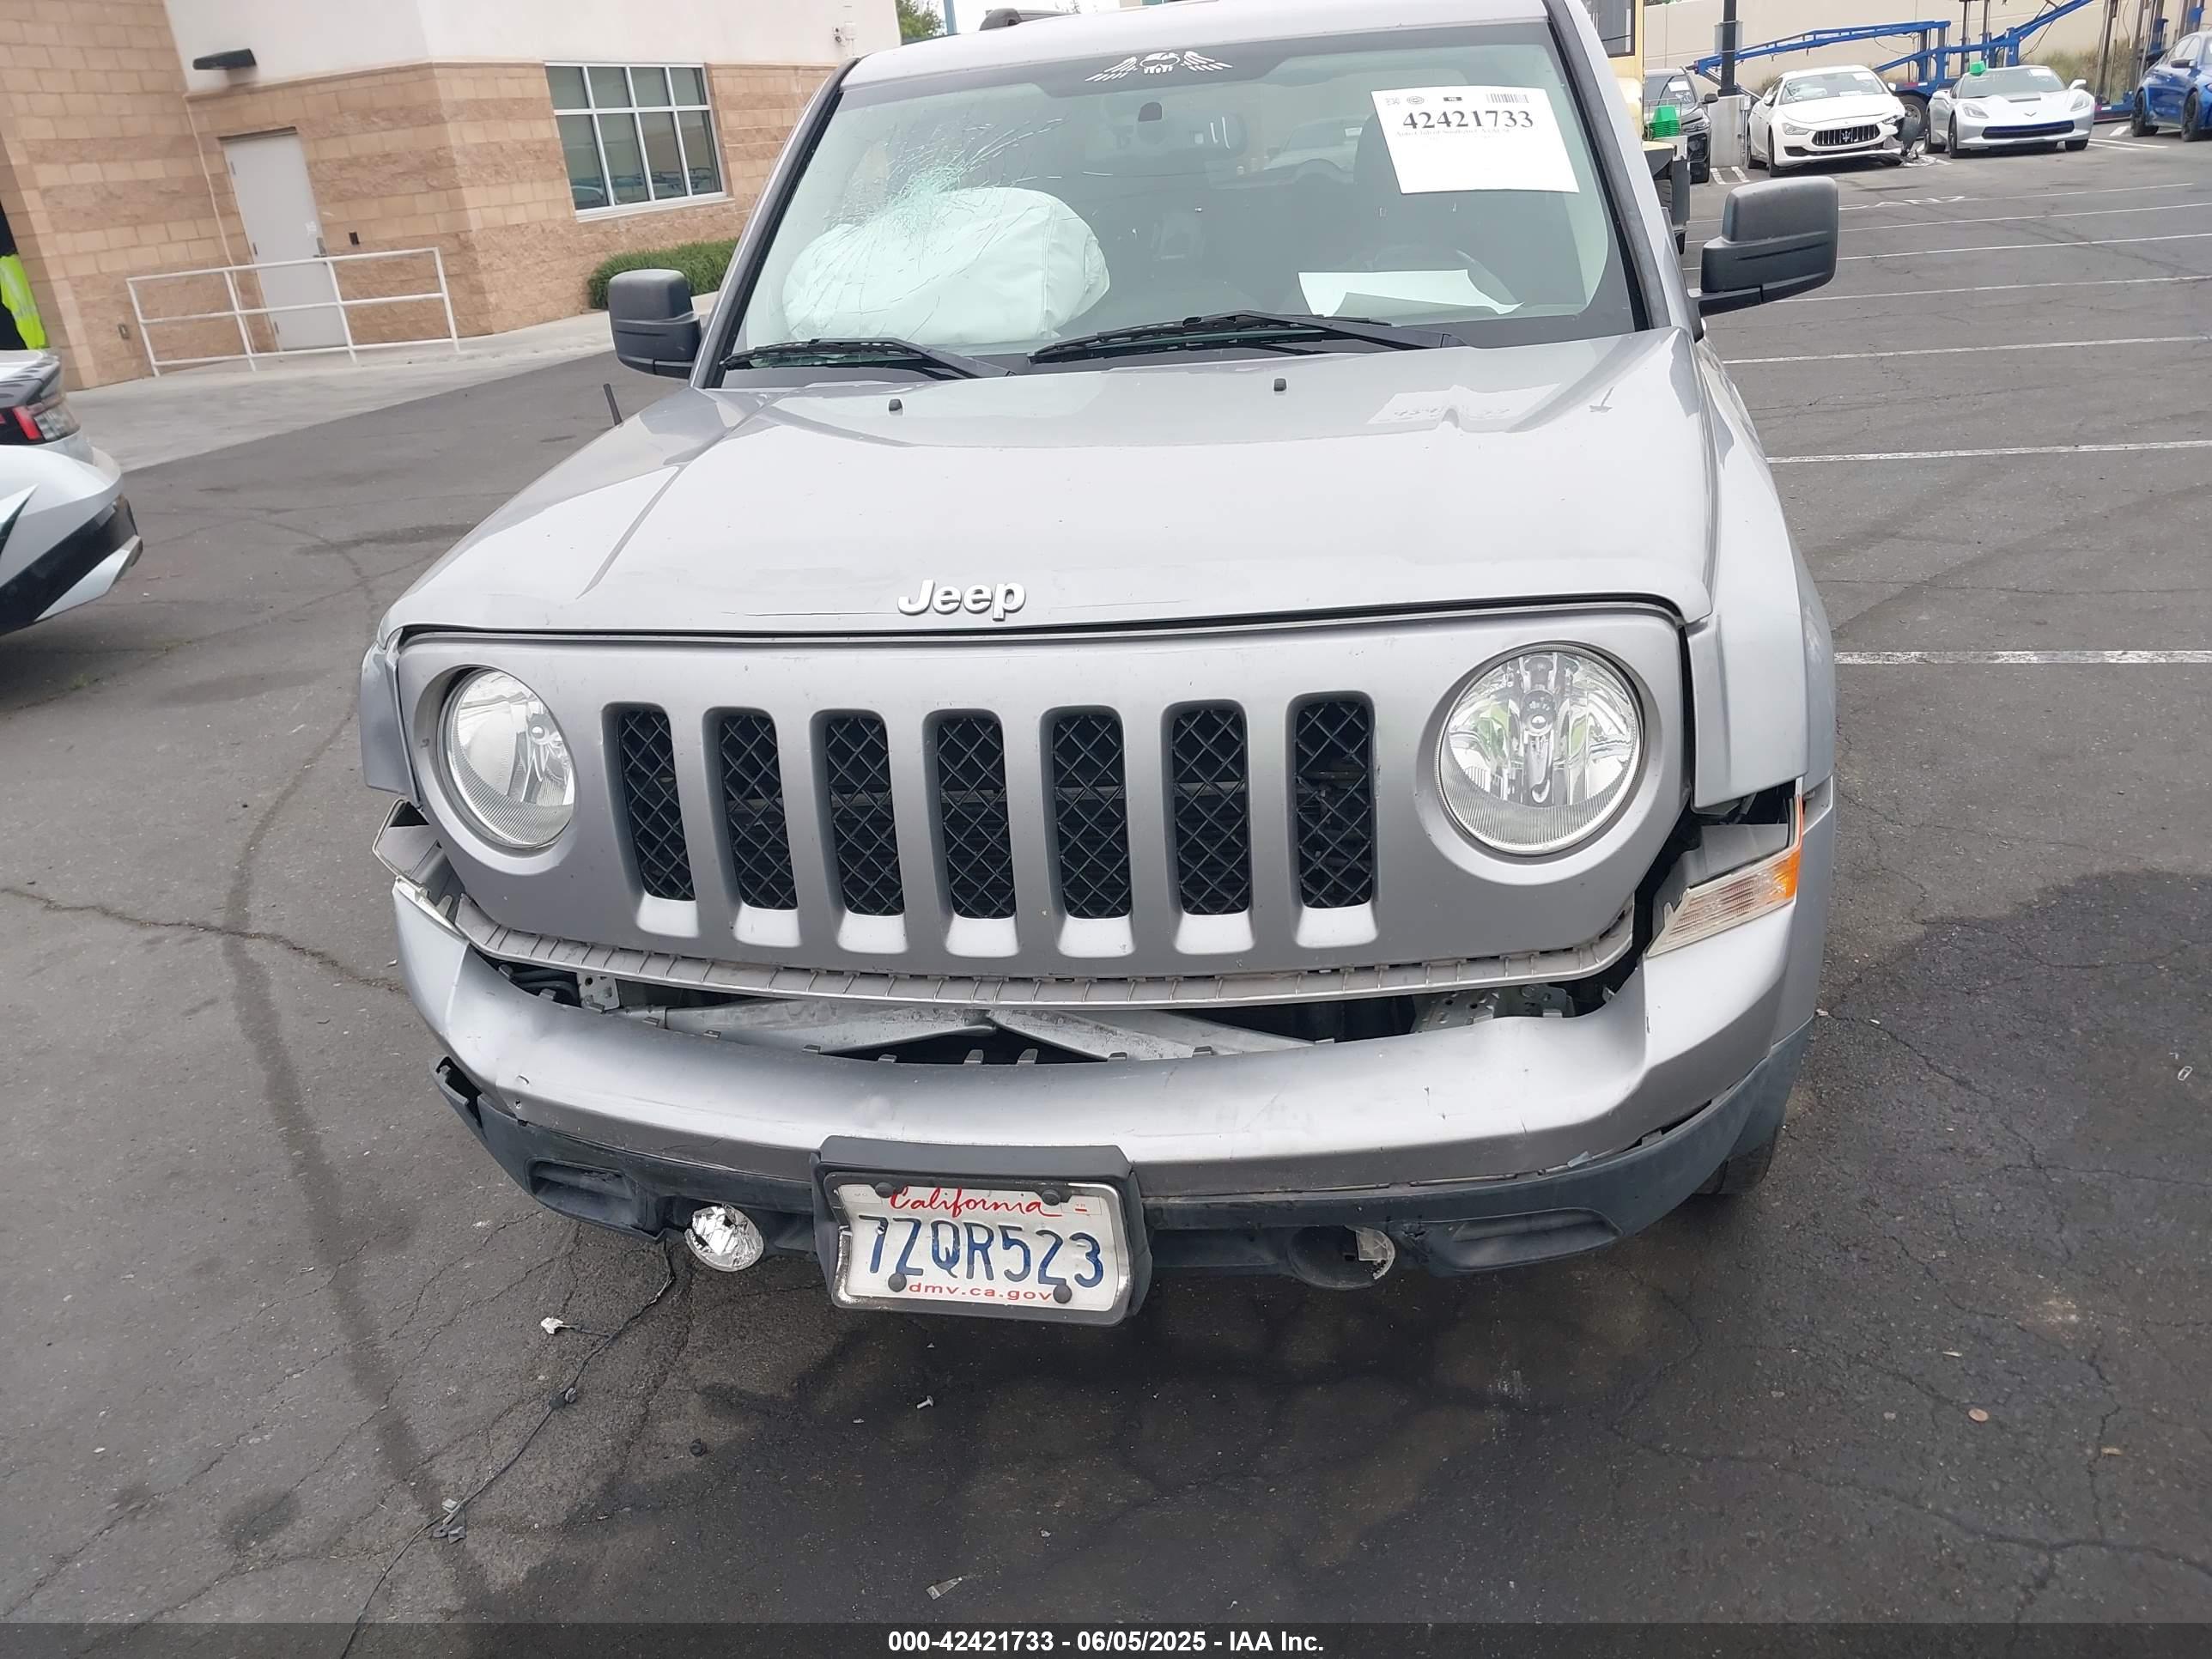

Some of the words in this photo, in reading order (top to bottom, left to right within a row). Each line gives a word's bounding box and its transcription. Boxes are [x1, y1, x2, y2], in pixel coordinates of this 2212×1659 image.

[1404, 111, 1534, 129] 42421733
[897, 579, 1026, 622] Jeep
[890, 1185, 1061, 1218] California
[859, 1214, 1104, 1287] 7ZQR523
[908, 1282, 1052, 1301] dmv.ca.gov
